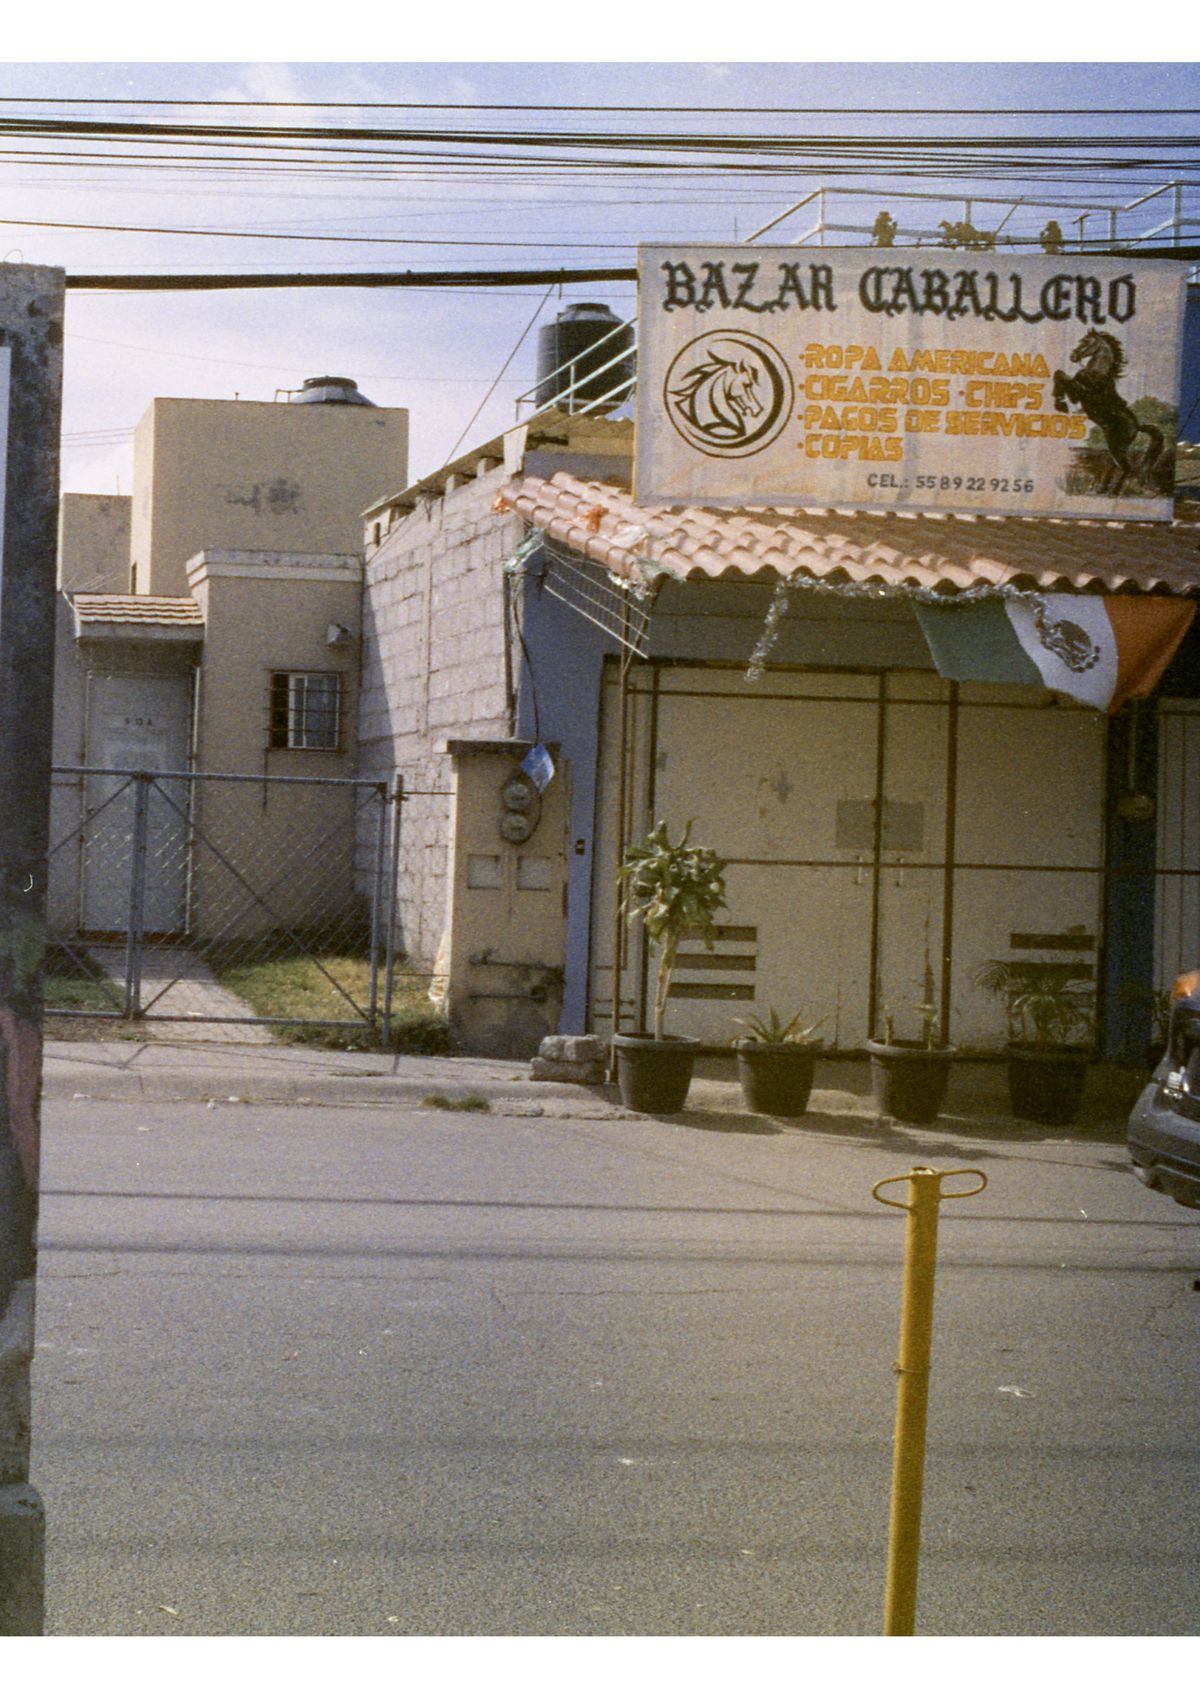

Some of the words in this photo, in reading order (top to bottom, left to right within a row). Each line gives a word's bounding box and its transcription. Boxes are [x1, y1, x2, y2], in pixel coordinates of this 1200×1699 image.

[661, 260, 838, 313] BAZAR
[858, 265, 1137, 324] CABALLERO
[805, 343, 882, 371] ROPA
[888, 347, 1050, 378] AMERICANA
[805, 374, 950, 406] CIGARROS
[966, 380, 1045, 410] CHIPS
[804, 405, 898, 433] PAGOS
[904, 409, 941, 433] DE
[945, 410, 1087, 440] SERVICIOS
[805, 433, 904, 462] COPIAS
